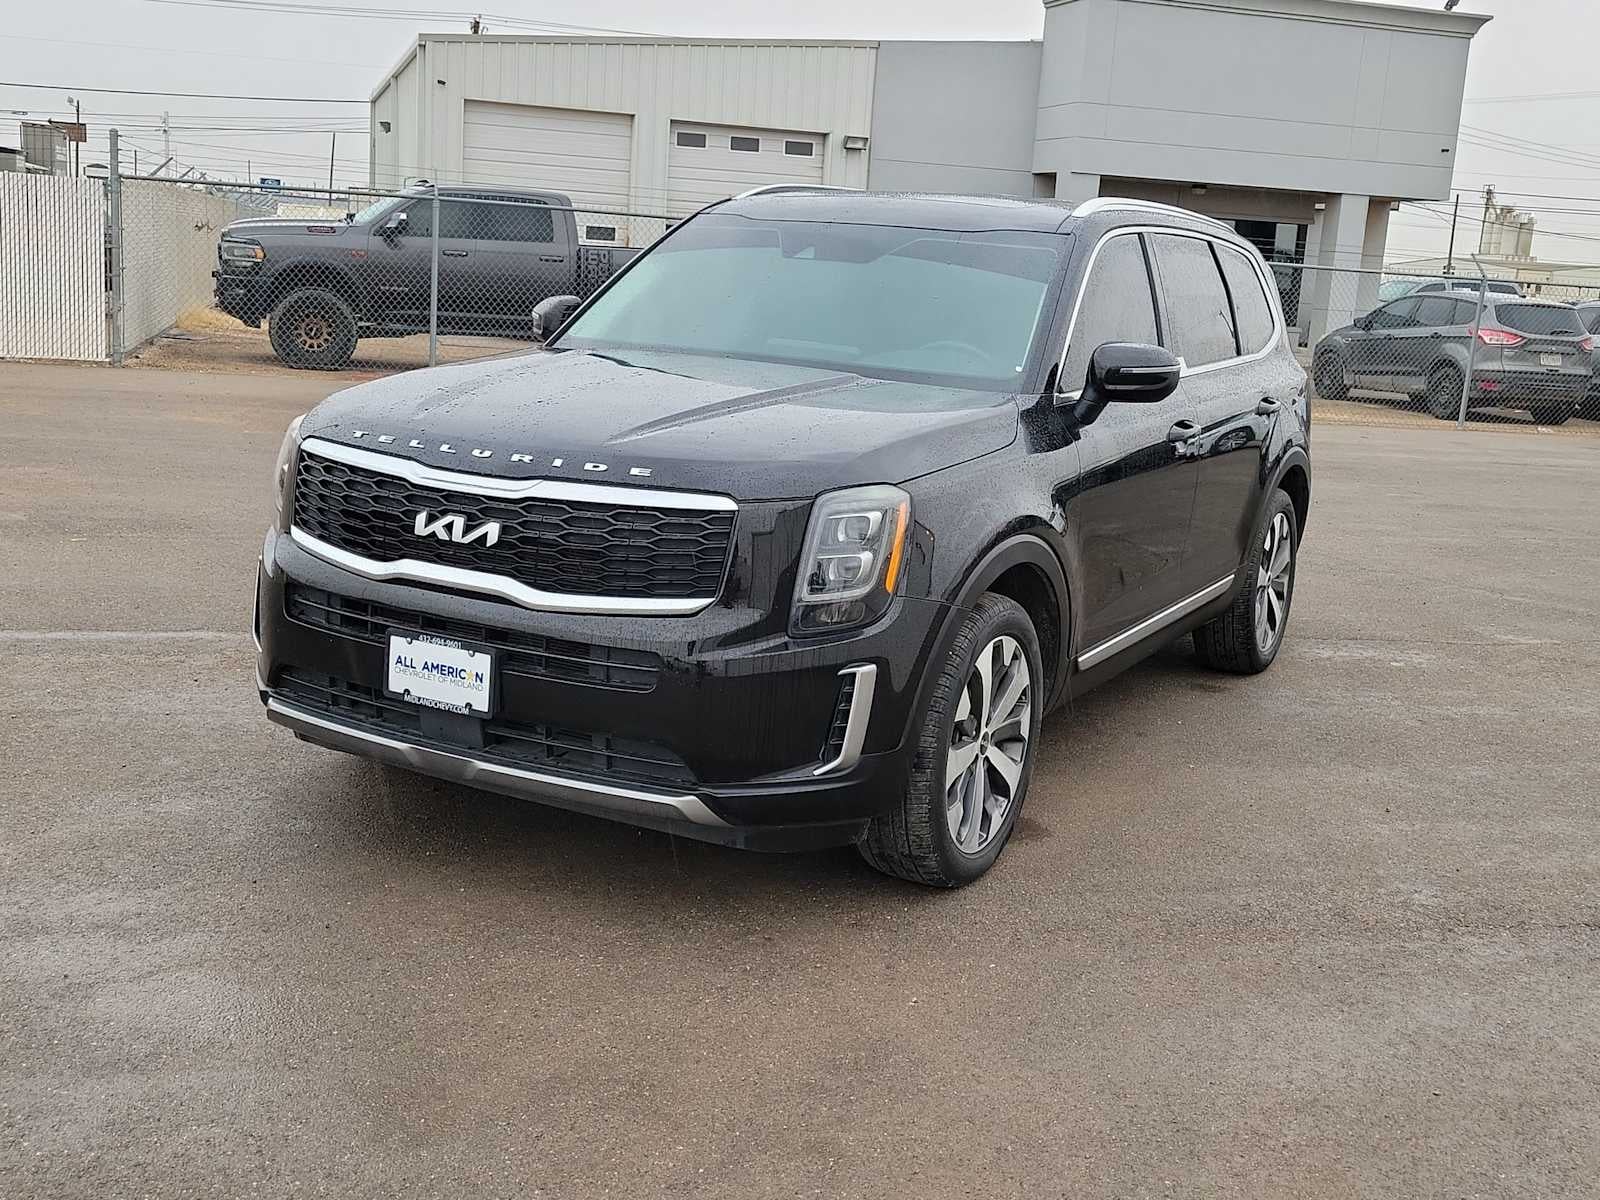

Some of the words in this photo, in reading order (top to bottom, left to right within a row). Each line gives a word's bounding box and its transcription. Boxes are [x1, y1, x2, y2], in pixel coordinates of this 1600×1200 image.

[351, 429, 653, 477] TELLURIDE
[414, 510, 500, 548] KIA
[395, 655, 417, 670] ALL
[394, 665, 437, 681] CHEVROLET
[438, 676, 449, 684] OF
[449, 679, 484, 692] MIDLAND
[403, 693, 470, 715] MIDLANDCHEVY.COM
